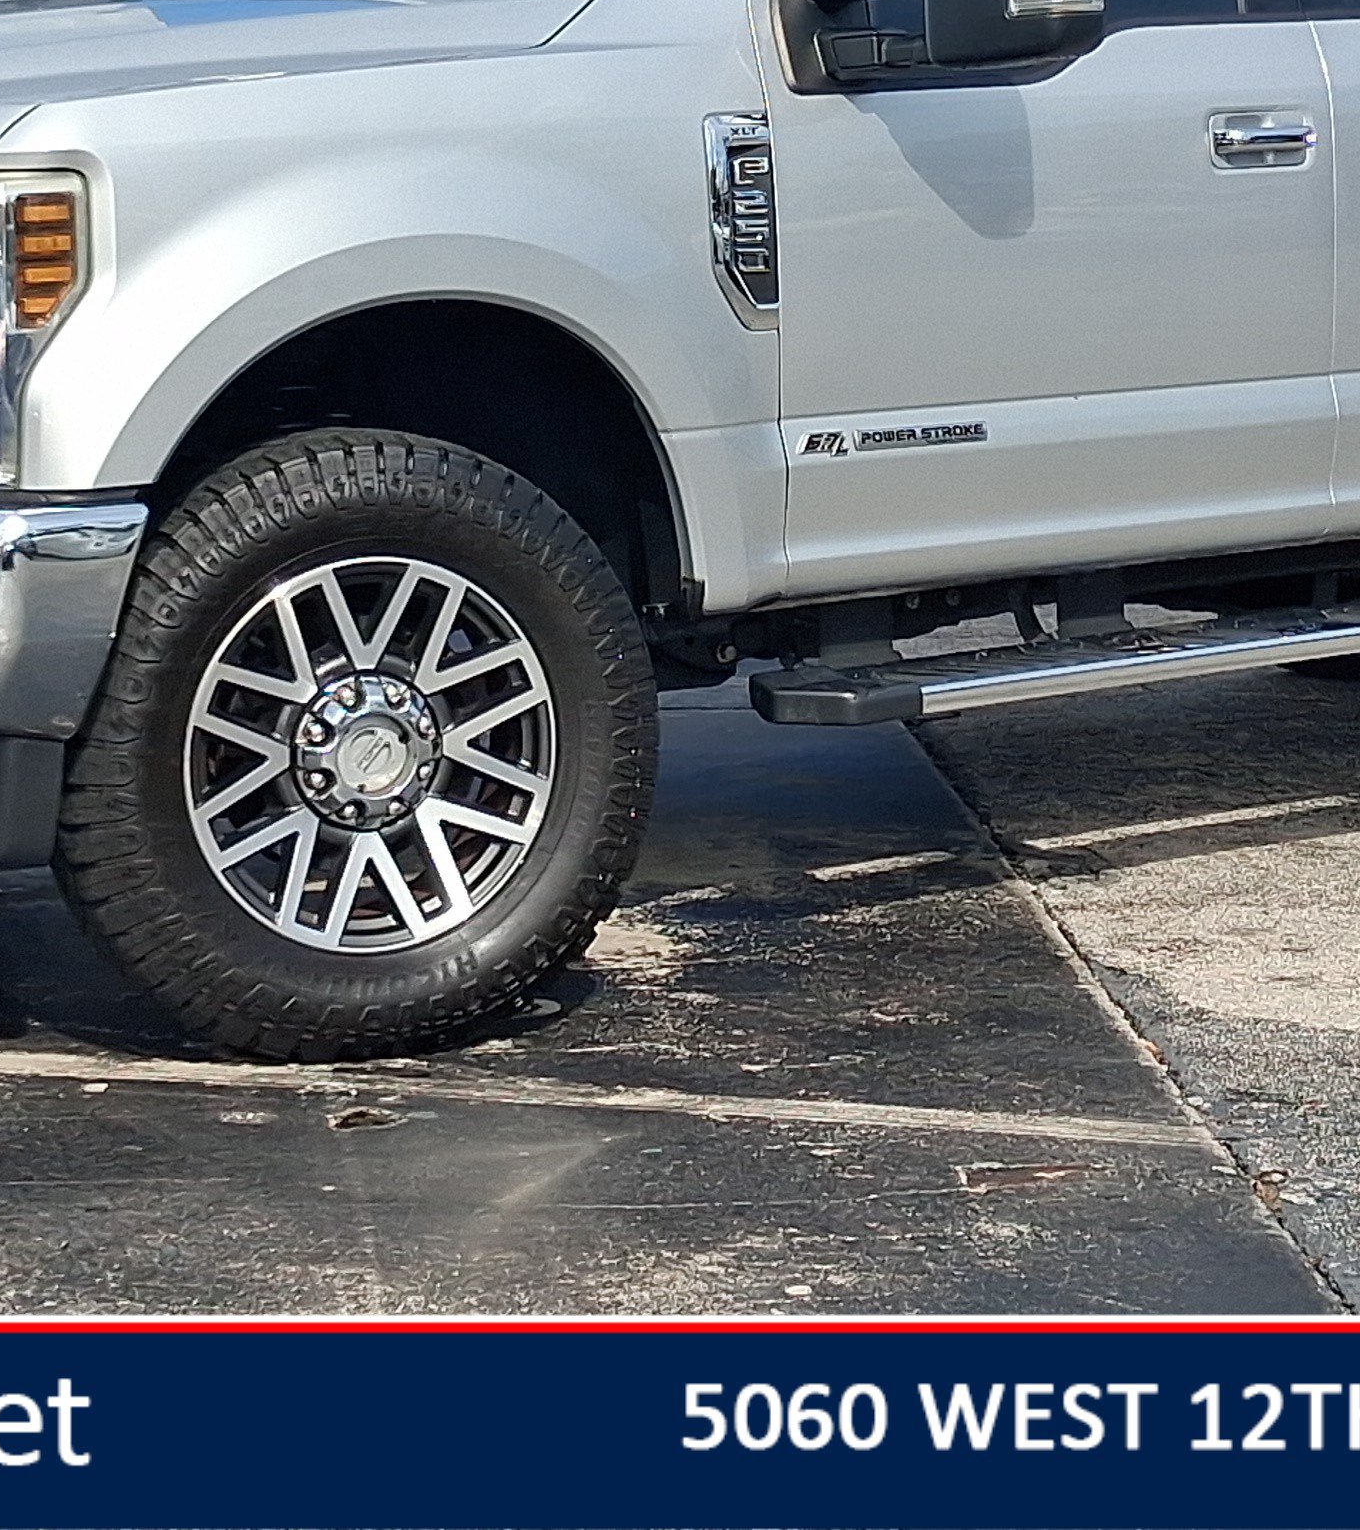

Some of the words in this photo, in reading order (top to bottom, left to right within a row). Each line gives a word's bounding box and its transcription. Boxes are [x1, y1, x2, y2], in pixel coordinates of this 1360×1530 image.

[730, 126, 759, 136] XLT
[860, 428, 917, 445] POWER
[921, 423, 985, 439] STROKE
